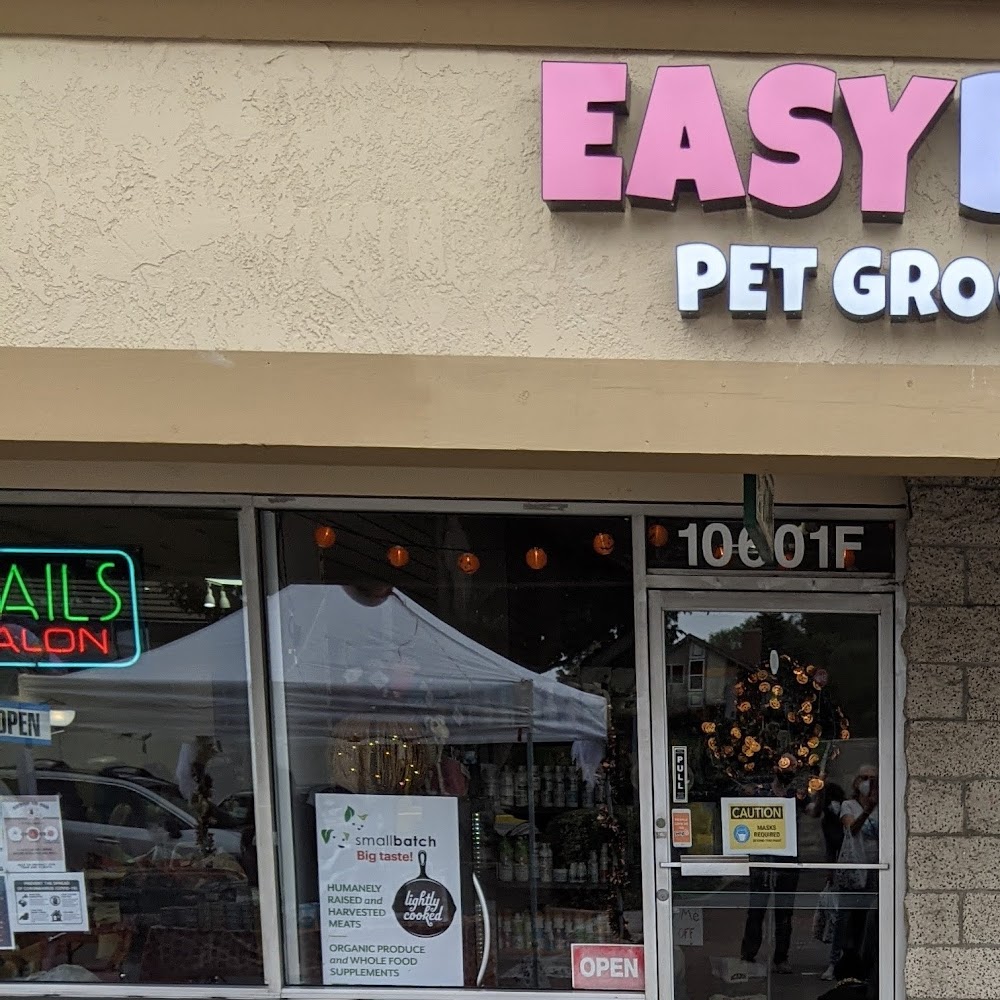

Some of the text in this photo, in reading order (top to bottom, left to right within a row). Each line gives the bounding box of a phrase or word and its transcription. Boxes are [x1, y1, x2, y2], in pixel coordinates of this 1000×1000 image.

[541, 60, 955, 216] EASY
[676, 243, 818, 315] PET
[678, 523, 865, 569] 10601F
[0, 709, 40, 737] OPEN
[676, 755, 685, 790] PULL
[731, 807, 782, 819] CAUTION
[355, 835, 437, 847] smallbatch
[356, 850, 413, 863] Big taste!
[327, 884, 382, 893] HUMANELY
[327, 896, 383, 905] RAISED and
[404, 889, 440, 912] lightly
[328, 908, 386, 917] HARVESTED
[403, 905, 444, 927] cooked
[328, 920, 361, 928] MEATS
[329, 944, 425, 954] ORGANIC PRODUCE
[329, 956, 418, 966] and WHOLE FOOD
[330, 968, 400, 977] SUPPLEMENTS
[579, 957, 639, 979] OPEN
